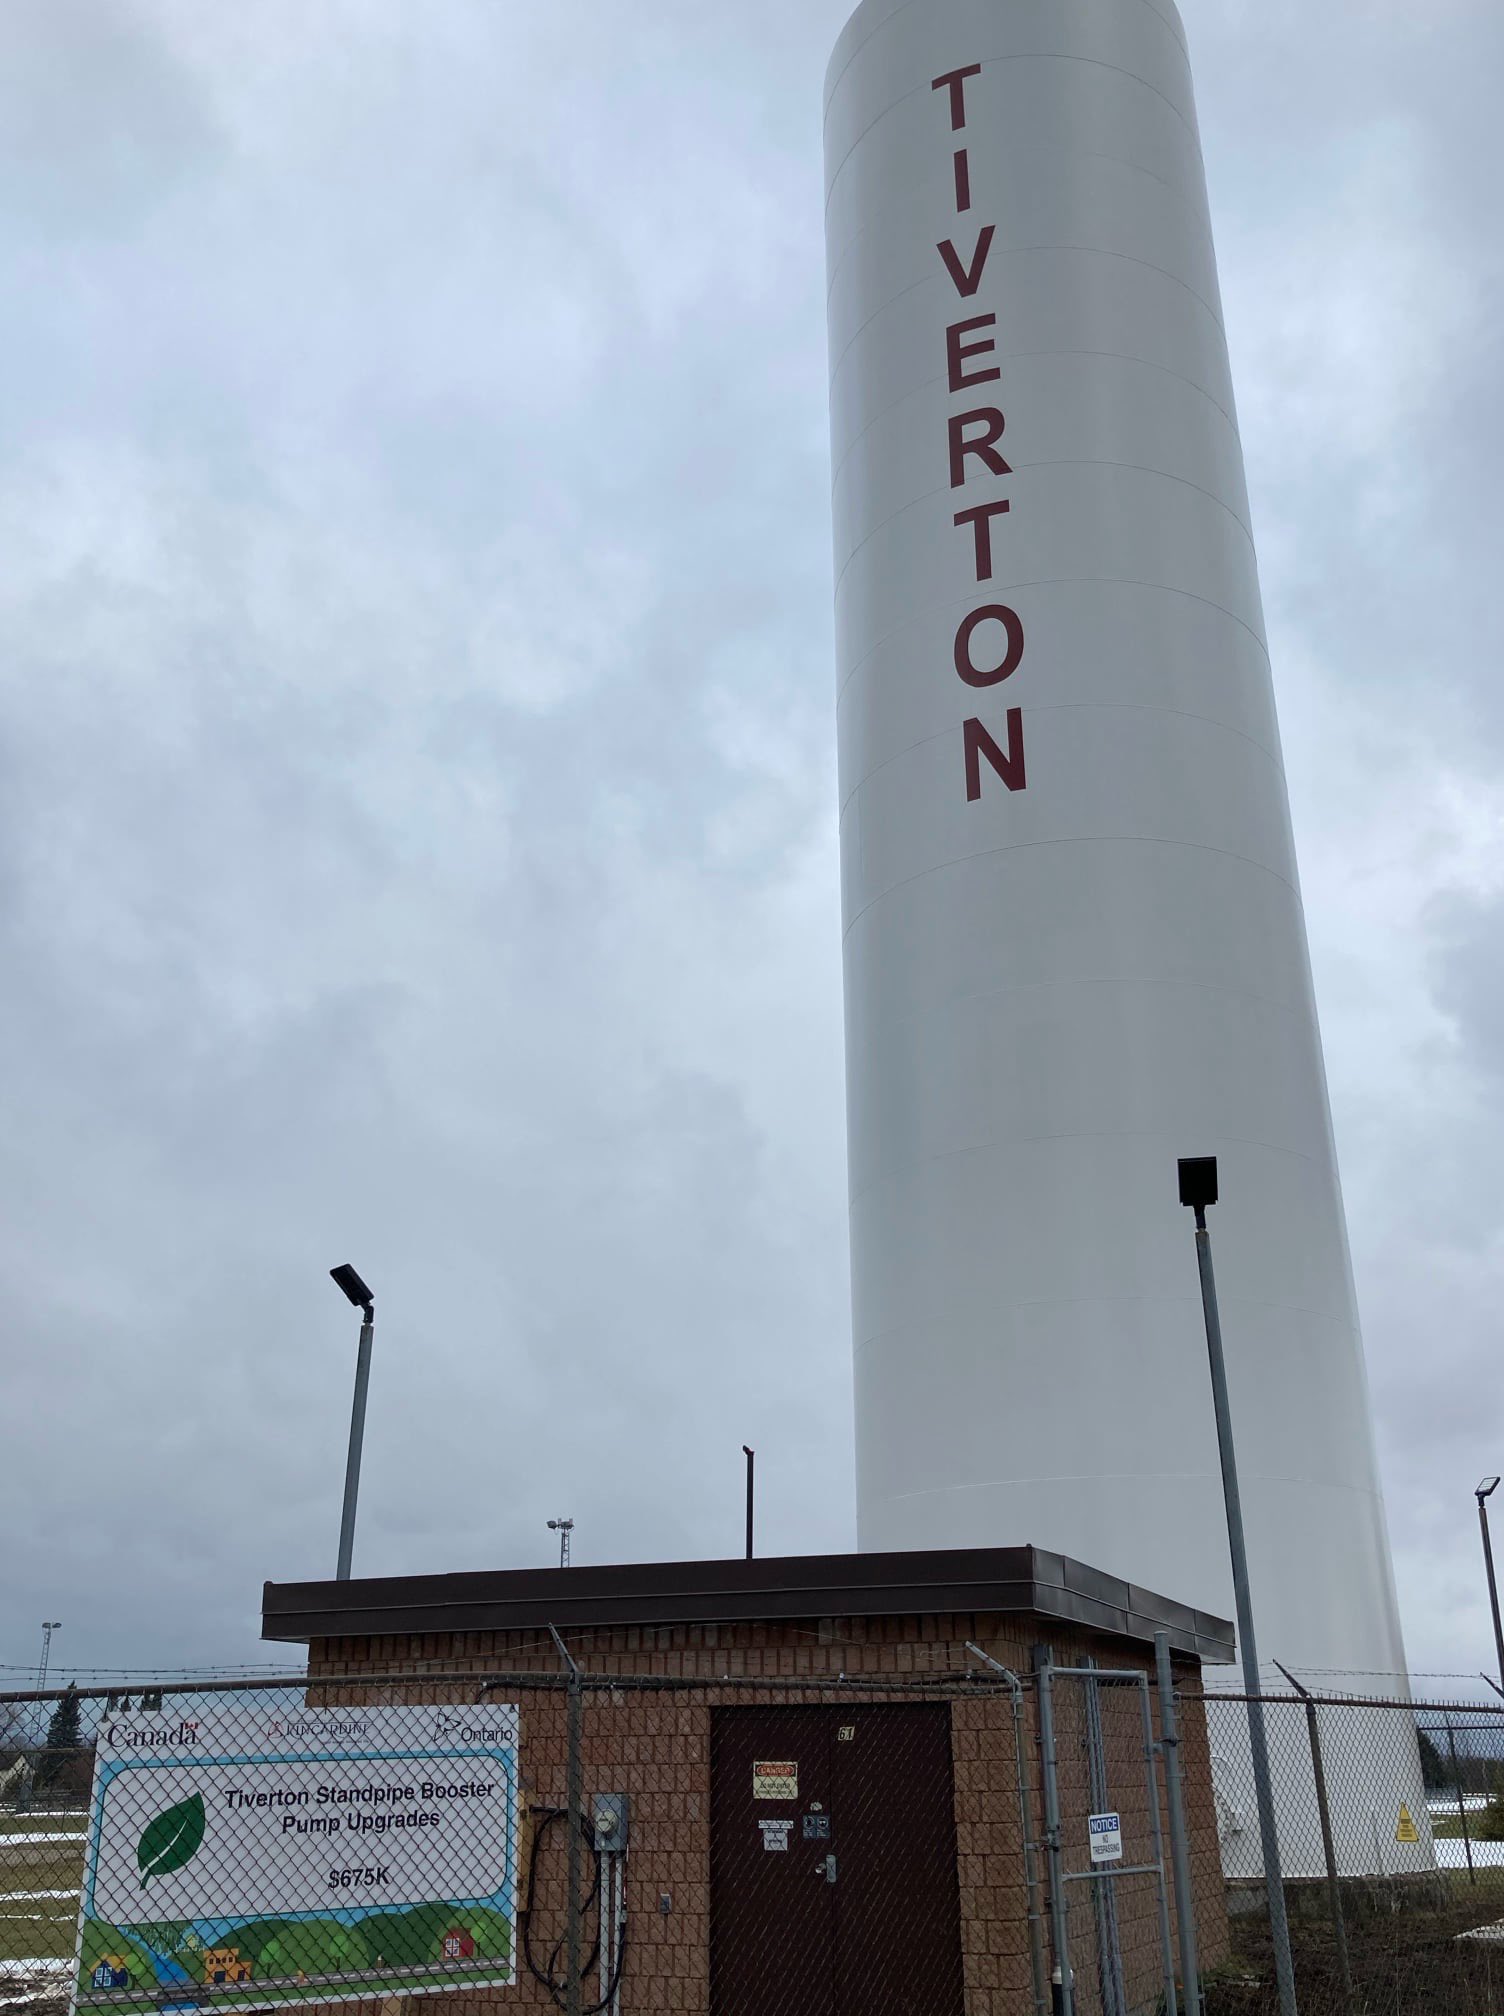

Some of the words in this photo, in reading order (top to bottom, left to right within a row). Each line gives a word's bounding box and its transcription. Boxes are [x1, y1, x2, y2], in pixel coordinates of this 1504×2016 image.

[931, 63, 1027, 802] TIVERTON
[107, 1722, 197, 1748] Canada
[461, 1727, 513, 1742] Ontario
[760, 1766, 791, 1775] DANGER
[225, 1788, 309, 1809] Tiverton
[316, 1784, 415, 1806] Standpipe
[421, 1781, 495, 1801] Booster
[282, 1815, 340, 1836] Pump
[347, 1810, 440, 1834] Upgrades
[1091, 1817, 1118, 1832] NOTICE
[1092, 1842, 1120, 1855] TRESPASSING
[328, 1866, 390, 1890] $675K
